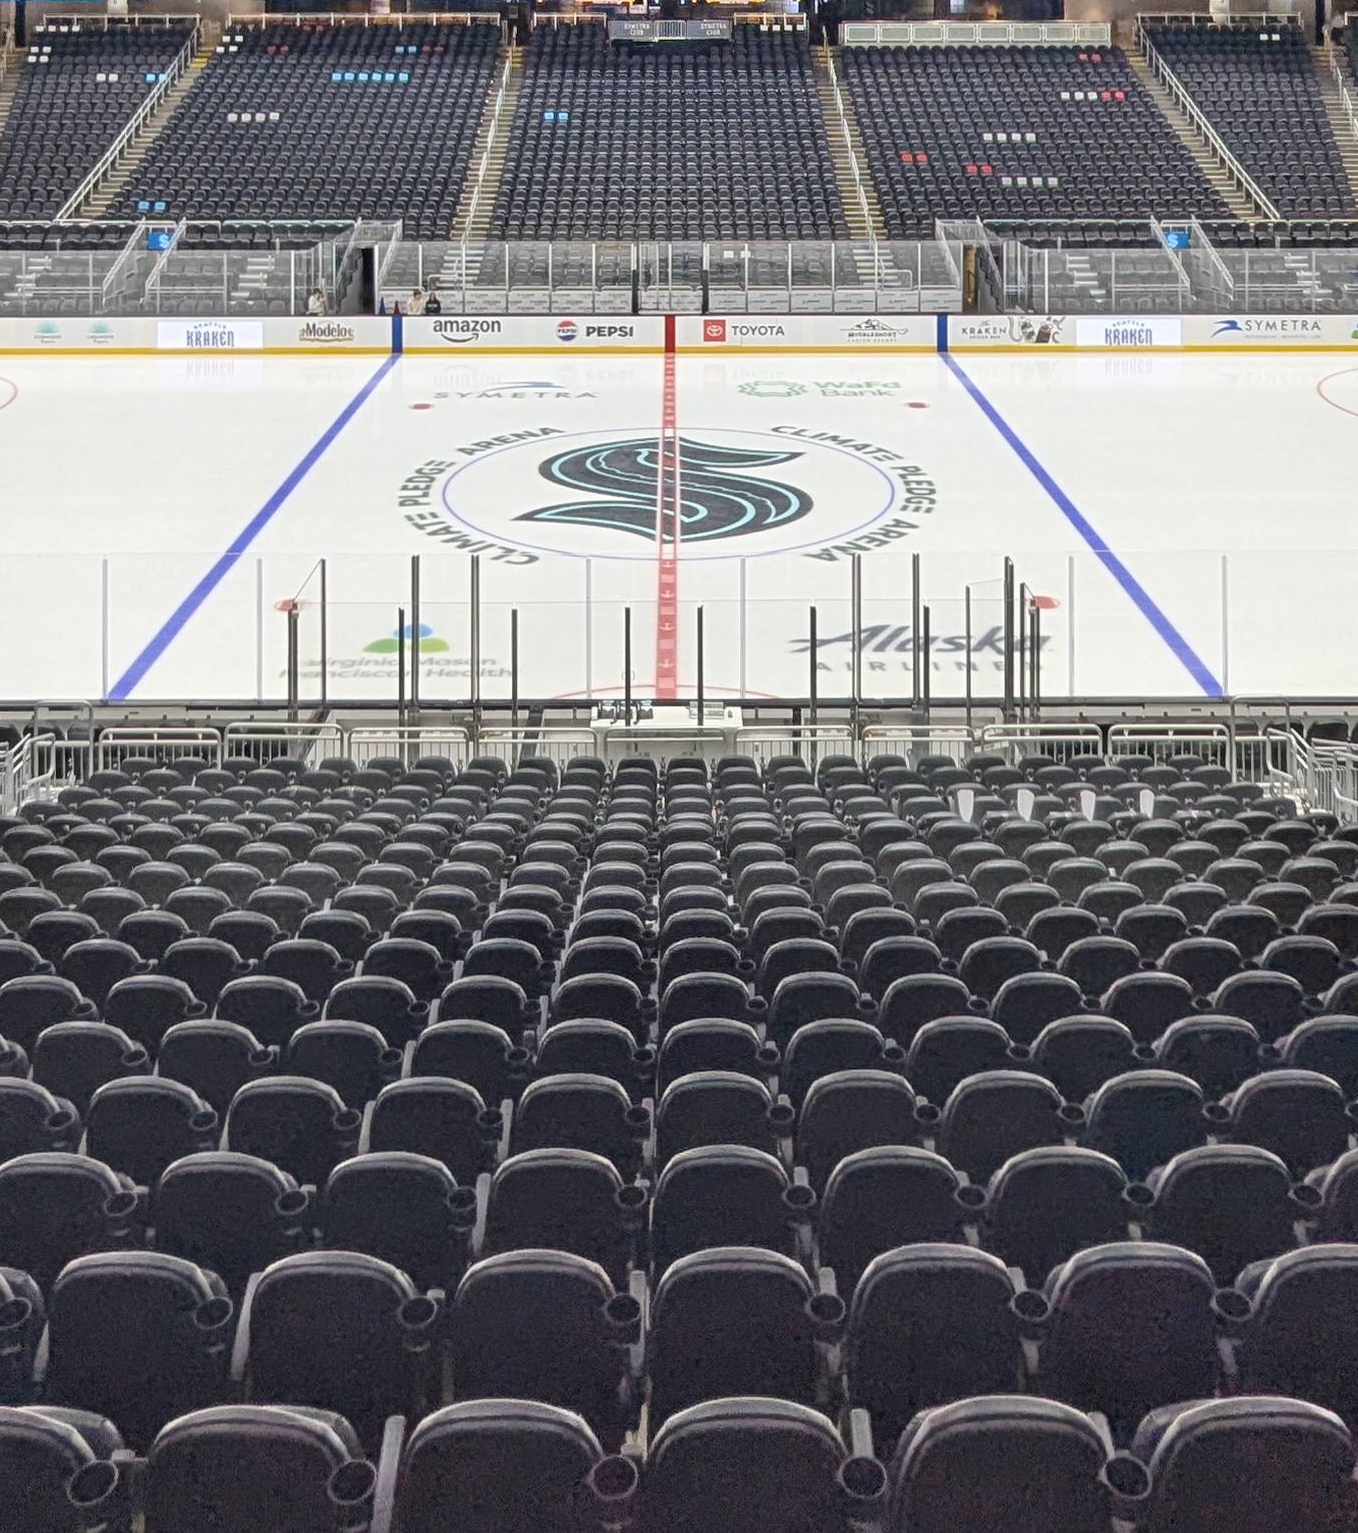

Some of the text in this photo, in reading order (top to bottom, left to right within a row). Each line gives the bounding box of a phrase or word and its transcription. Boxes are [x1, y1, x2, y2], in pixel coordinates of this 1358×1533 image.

[193, 322, 226, 330] SEATTLE
[305, 322, 347, 338] Modelo
[433, 319, 501, 334] amazon
[585, 325, 633, 337] PEPSI
[731, 325, 785, 336] TOYOTA
[961, 327, 1007, 335] KRAKEN
[1245, 320, 1321, 331] SYMETRA
[186, 330, 234, 347] KRAKEN
[1105, 328, 1153, 345] KRAKEN
[814, 380, 902, 390] WaFd
[821, 388, 895, 397] Bank
[432, 391, 598, 400] SYMETRA
[455, 424, 565, 456] ARENA
[770, 424, 904, 462] CLIMATE
[398, 459, 456, 508] PLEDGE
[896, 464, 938, 515] PLEDGE
[404, 512, 540, 567] CLIMATE
[803, 517, 921, 563] ARENA
